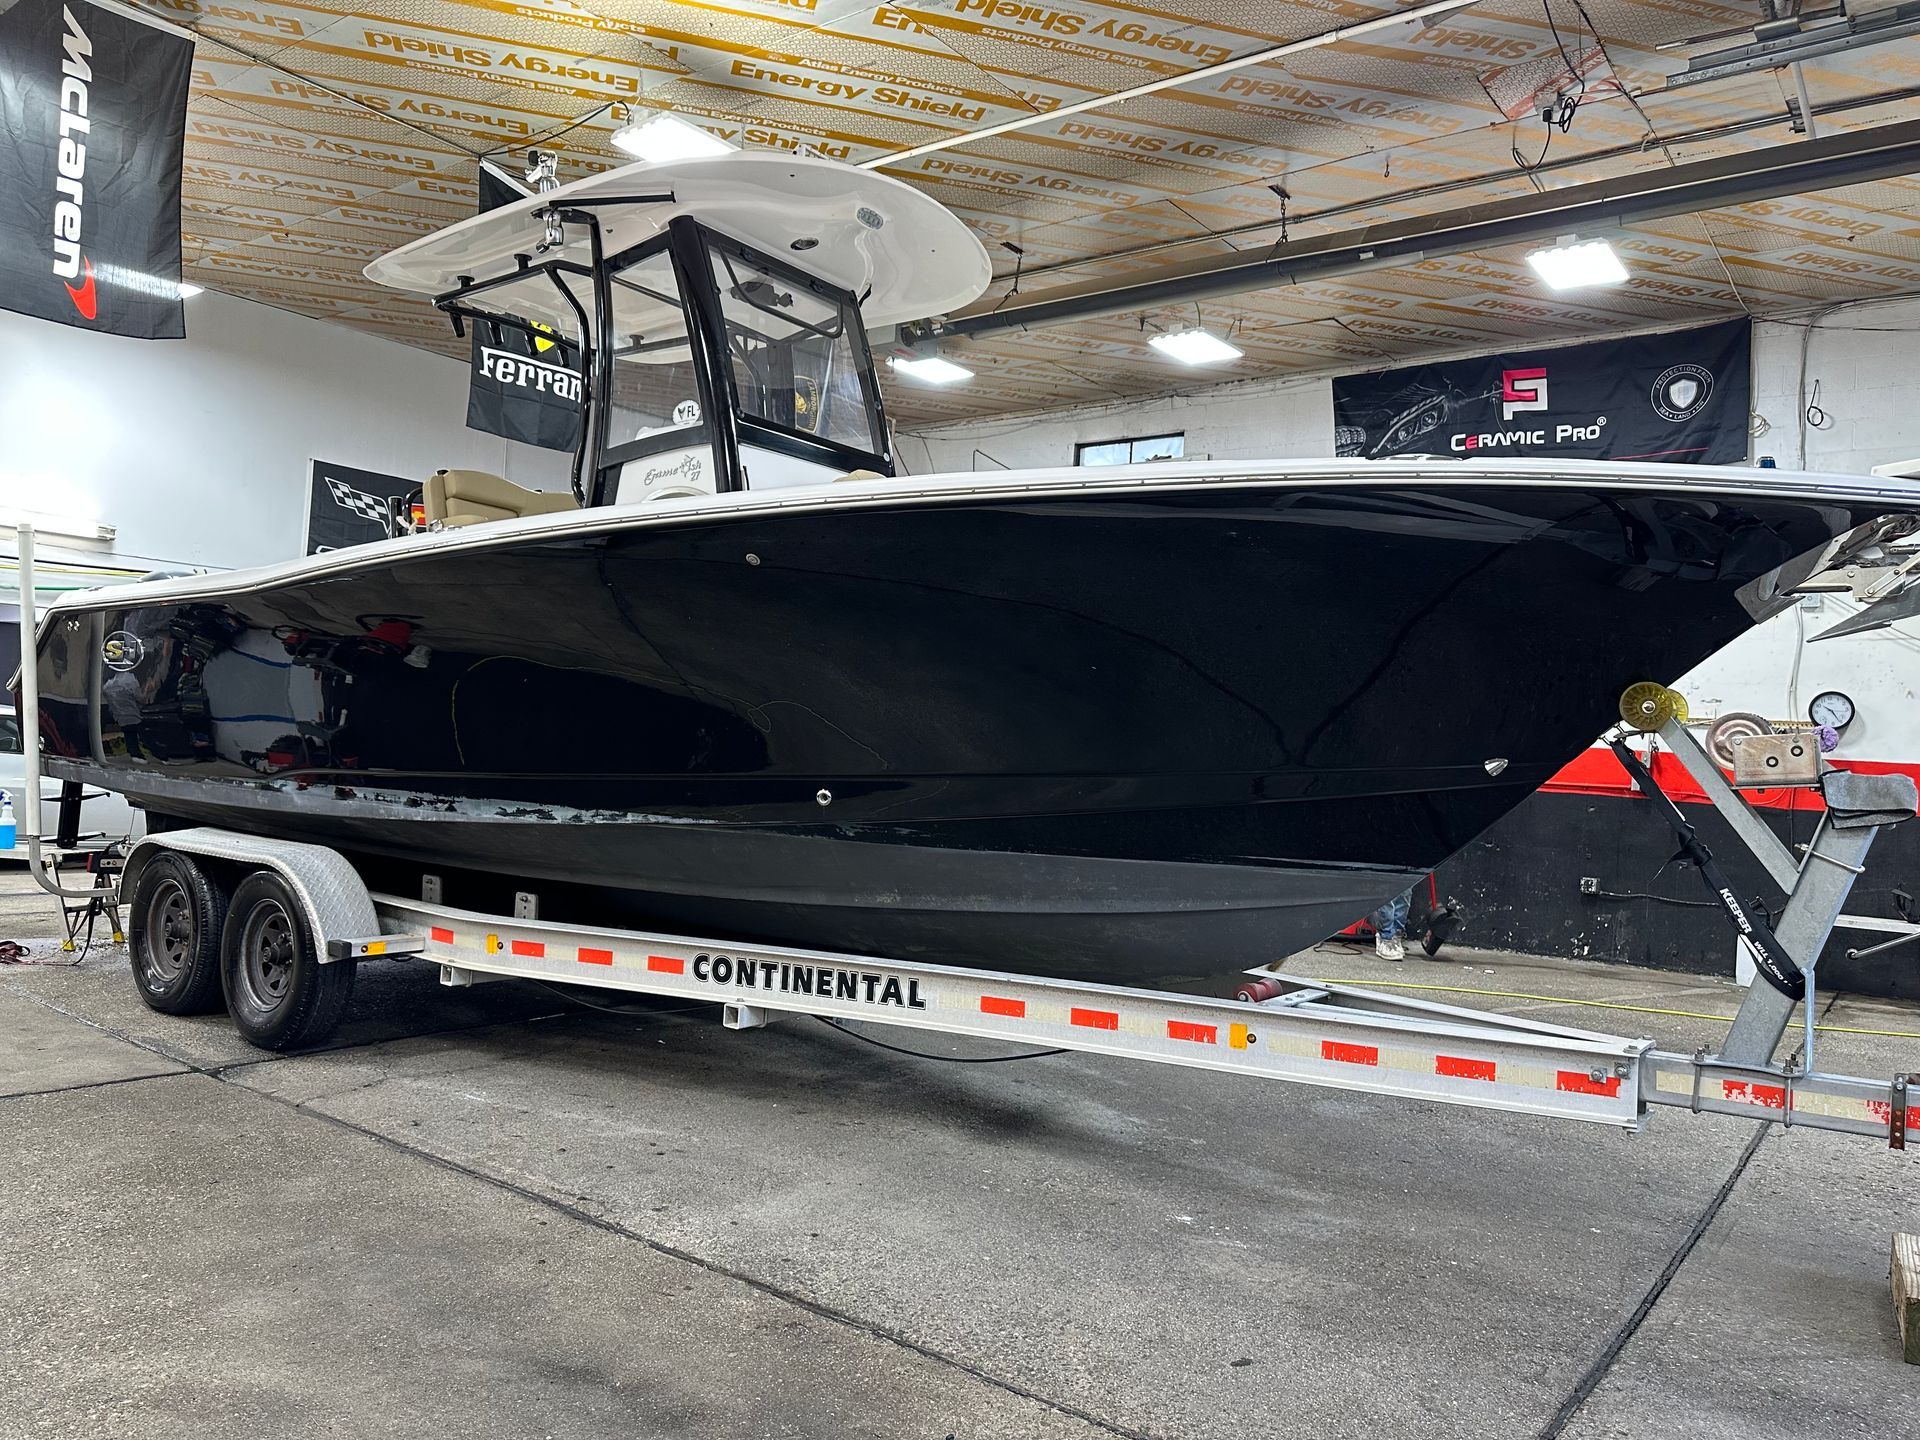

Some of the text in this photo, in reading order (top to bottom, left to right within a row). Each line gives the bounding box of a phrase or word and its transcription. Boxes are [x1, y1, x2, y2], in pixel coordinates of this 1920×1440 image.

[515, 6, 594, 29] Products
[954, 0, 1087, 35] Shield
[364, 31, 492, 66] Shield
[981, 27, 1151, 68] Atlas Energy Products
[1088, 19, 1233, 64] Energy
[1409, 26, 1537, 59] Shield
[405, 60, 478, 80] Products
[480, 72, 535, 90] Energy
[498, 53, 639, 92] Energy
[799, 59, 962, 95] Atlas Energy Products
[538, 83, 577, 95] Atlas
[730, 59, 867, 100] Energy
[871, 85, 987, 122] Shield
[1218, 76, 1337, 109] Shield
[399, 99, 528, 135] Energy
[671, 103, 709, 116] Atlas
[710, 109, 763, 126] Energy
[763, 118, 828, 136] Products
[192, 121, 307, 149] Shield
[1058, 121, 1290, 174] Energy Shield
[313, 136, 435, 171] Energy
[508, 147, 617, 173] Eergy
[238, 171, 356, 200] Energy
[921, 158, 1140, 207] Energy Shield
[1780, 252, 1872, 275] Shield
[479, 346, 582, 403] Ferrar
[1656, 366, 1697, 389] PROTECTION
[687, 404, 696, 418] FL
[1720, 888, 1784, 981] KEEPER WLL 1,000
[692, 953, 927, 1010] CONTINENTAL
